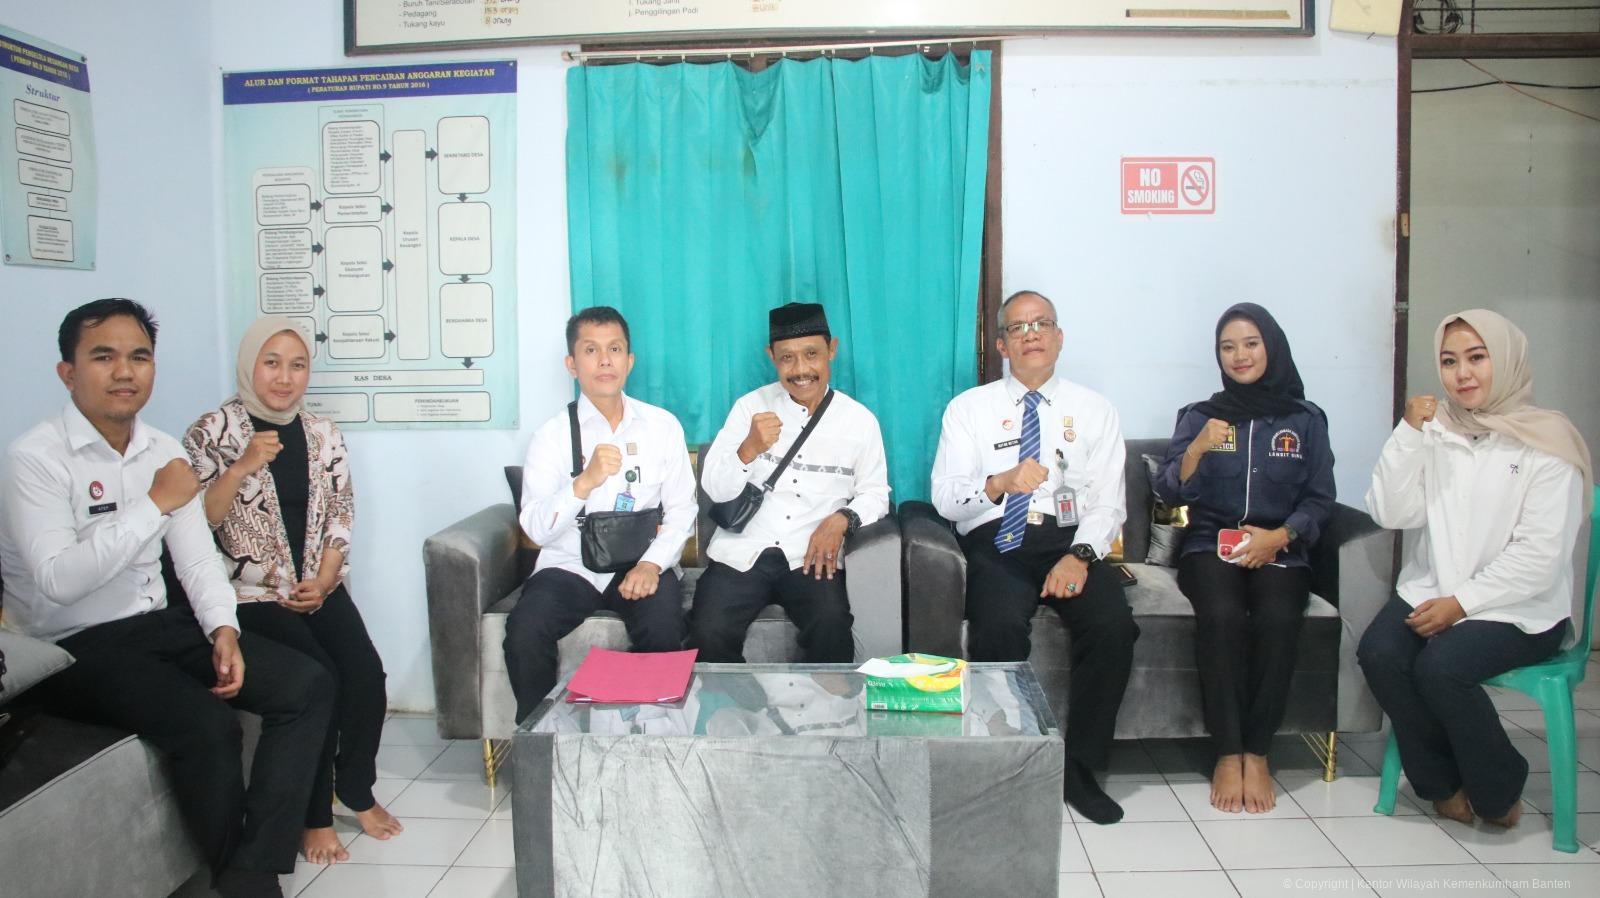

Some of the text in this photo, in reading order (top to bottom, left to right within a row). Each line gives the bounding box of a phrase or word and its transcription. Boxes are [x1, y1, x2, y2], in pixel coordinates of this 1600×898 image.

[635, 8, 680, 16] Penggilingan
[403, 20, 428, 28] Tukang
[245, 68, 495, 87] ALUR DAN FORMAT TAHAPAN PENCAIRAN ANGGARAN KEGIATAN
[26, 82, 61, 102] Struktur
[1140, 168, 1160, 186] NO
[1128, 190, 1174, 204] SMOKING
